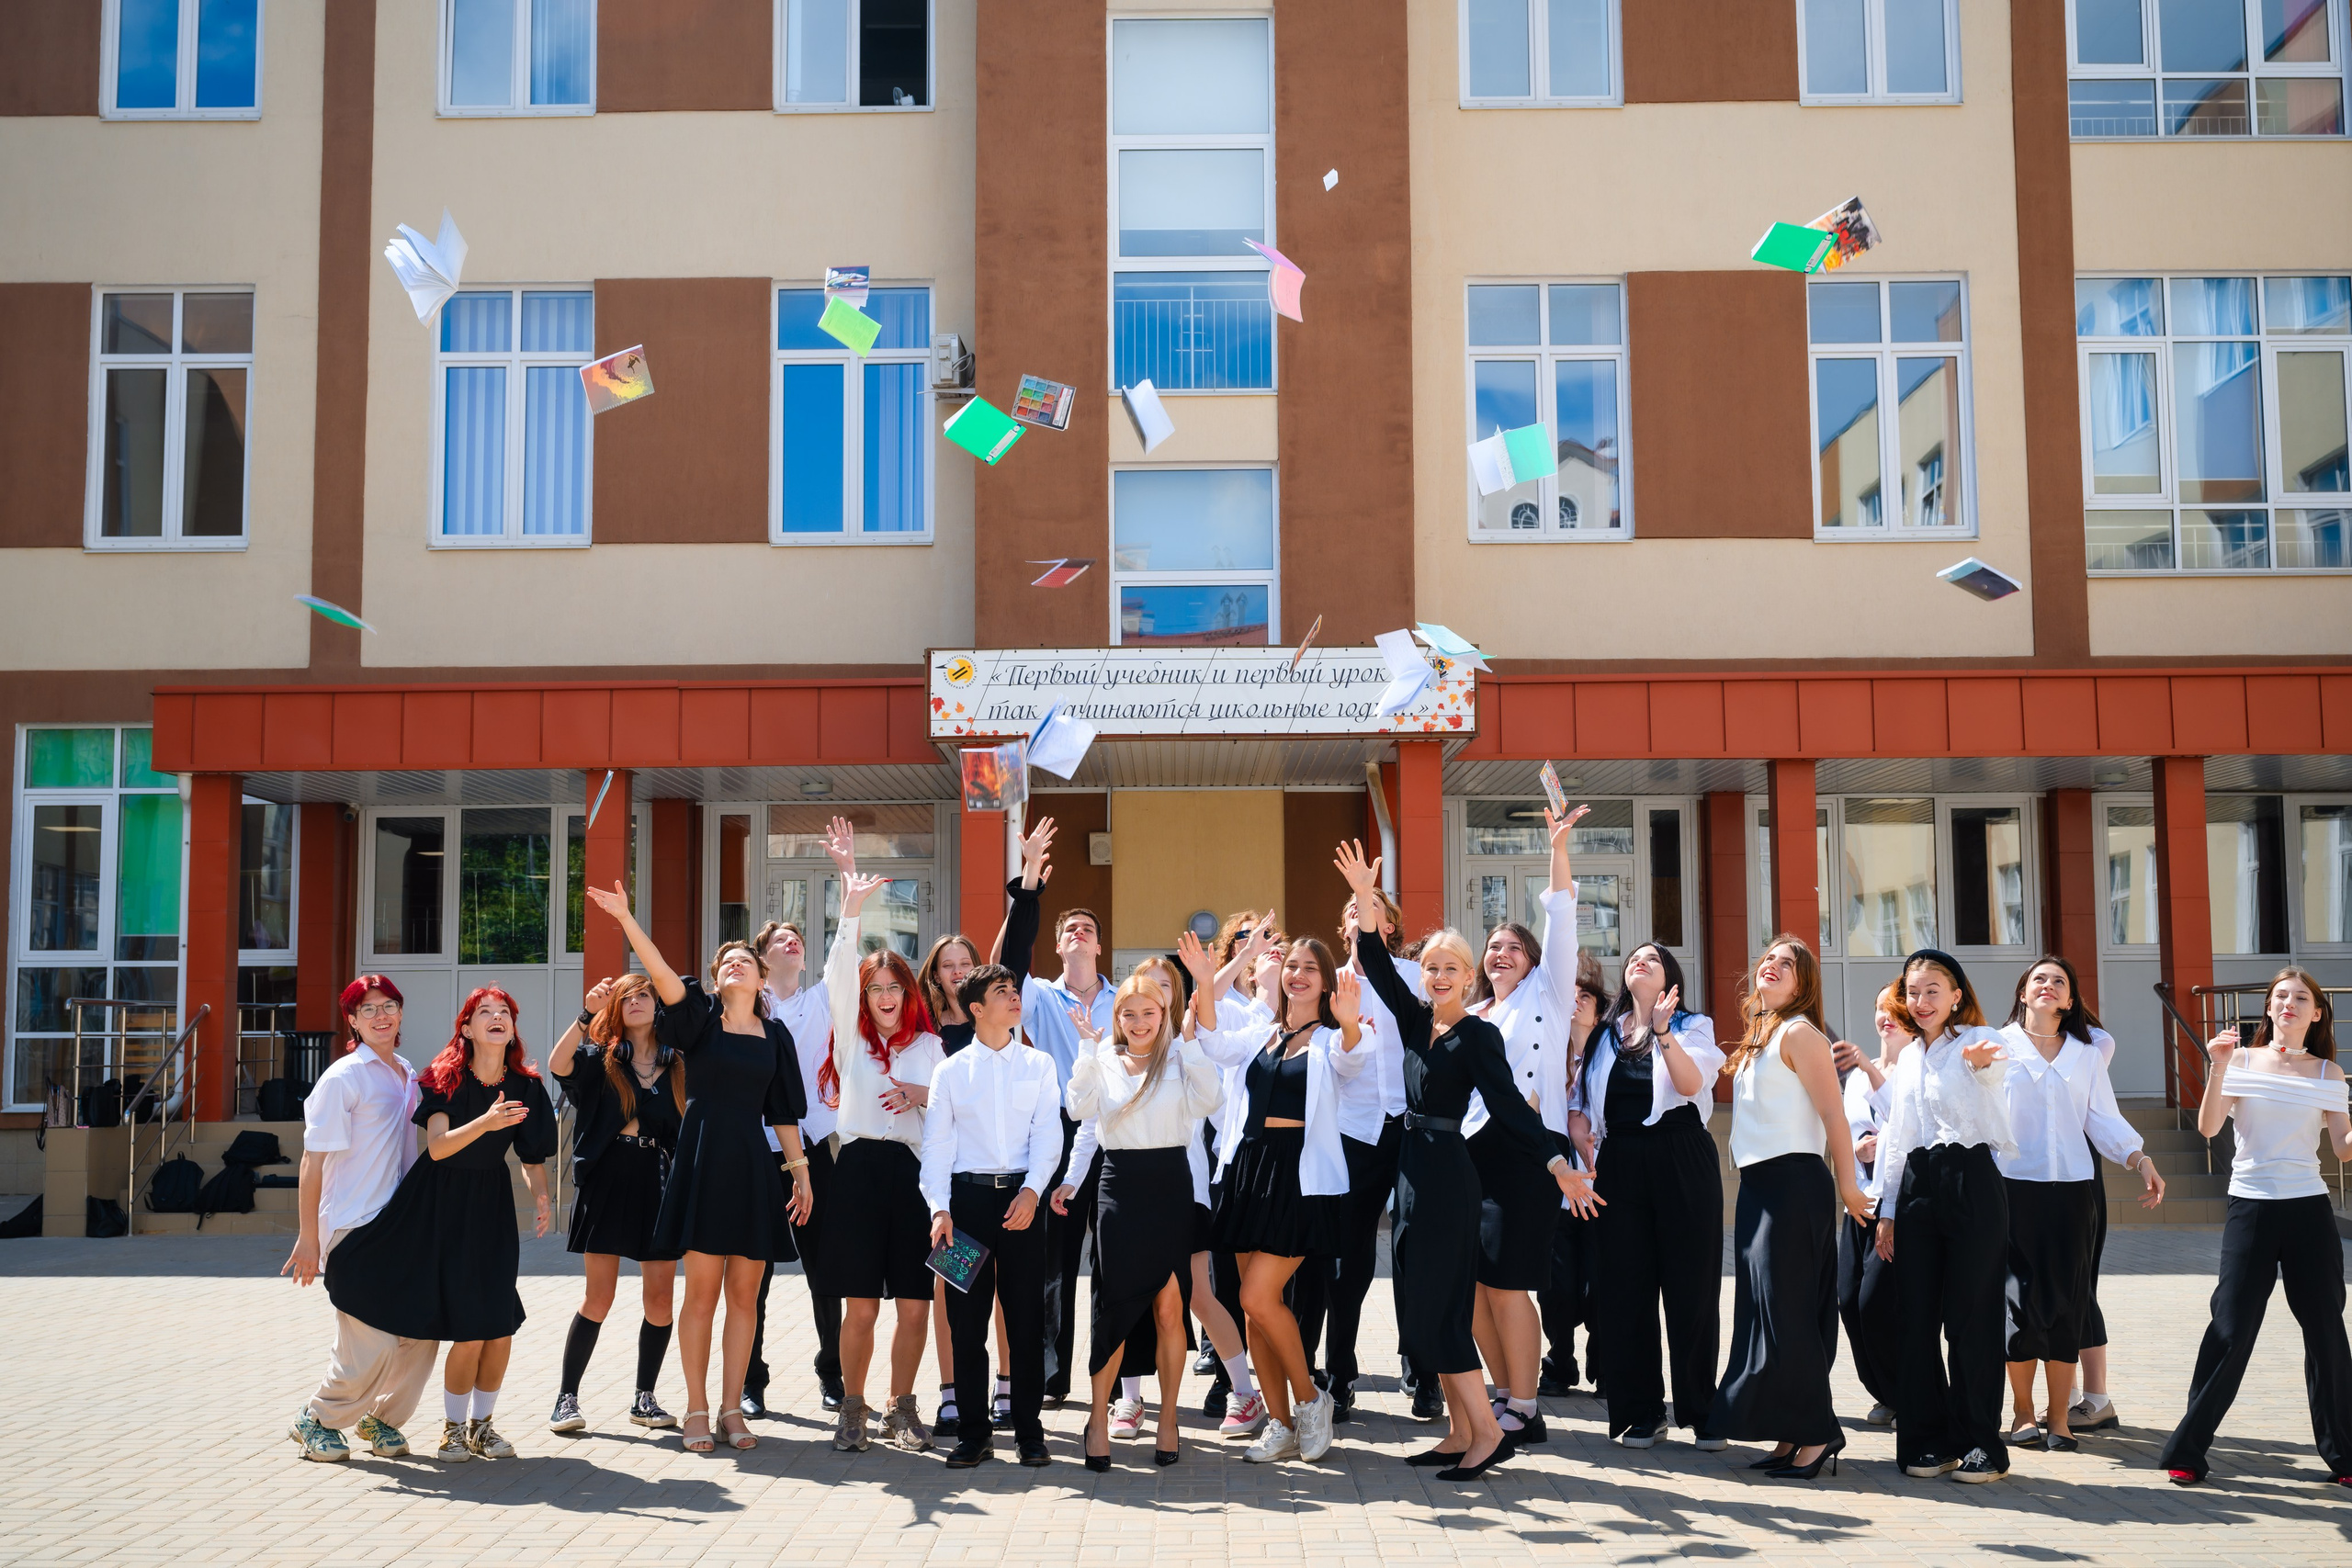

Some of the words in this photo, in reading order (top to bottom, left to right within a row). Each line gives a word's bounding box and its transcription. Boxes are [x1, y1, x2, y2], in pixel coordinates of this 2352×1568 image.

[1102, 661, 1202, 690] учебник
[1213, 669, 1227, 682] и
[1236, 660, 1324, 689] первый
[1329, 668, 1389, 688] урок
[989, 700, 1041, 719] так
[1053, 698, 1204, 719] ачинаются
[1208, 703, 1332, 721] школьные
[941, 1245, 973, 1268] ХИМИЯ
